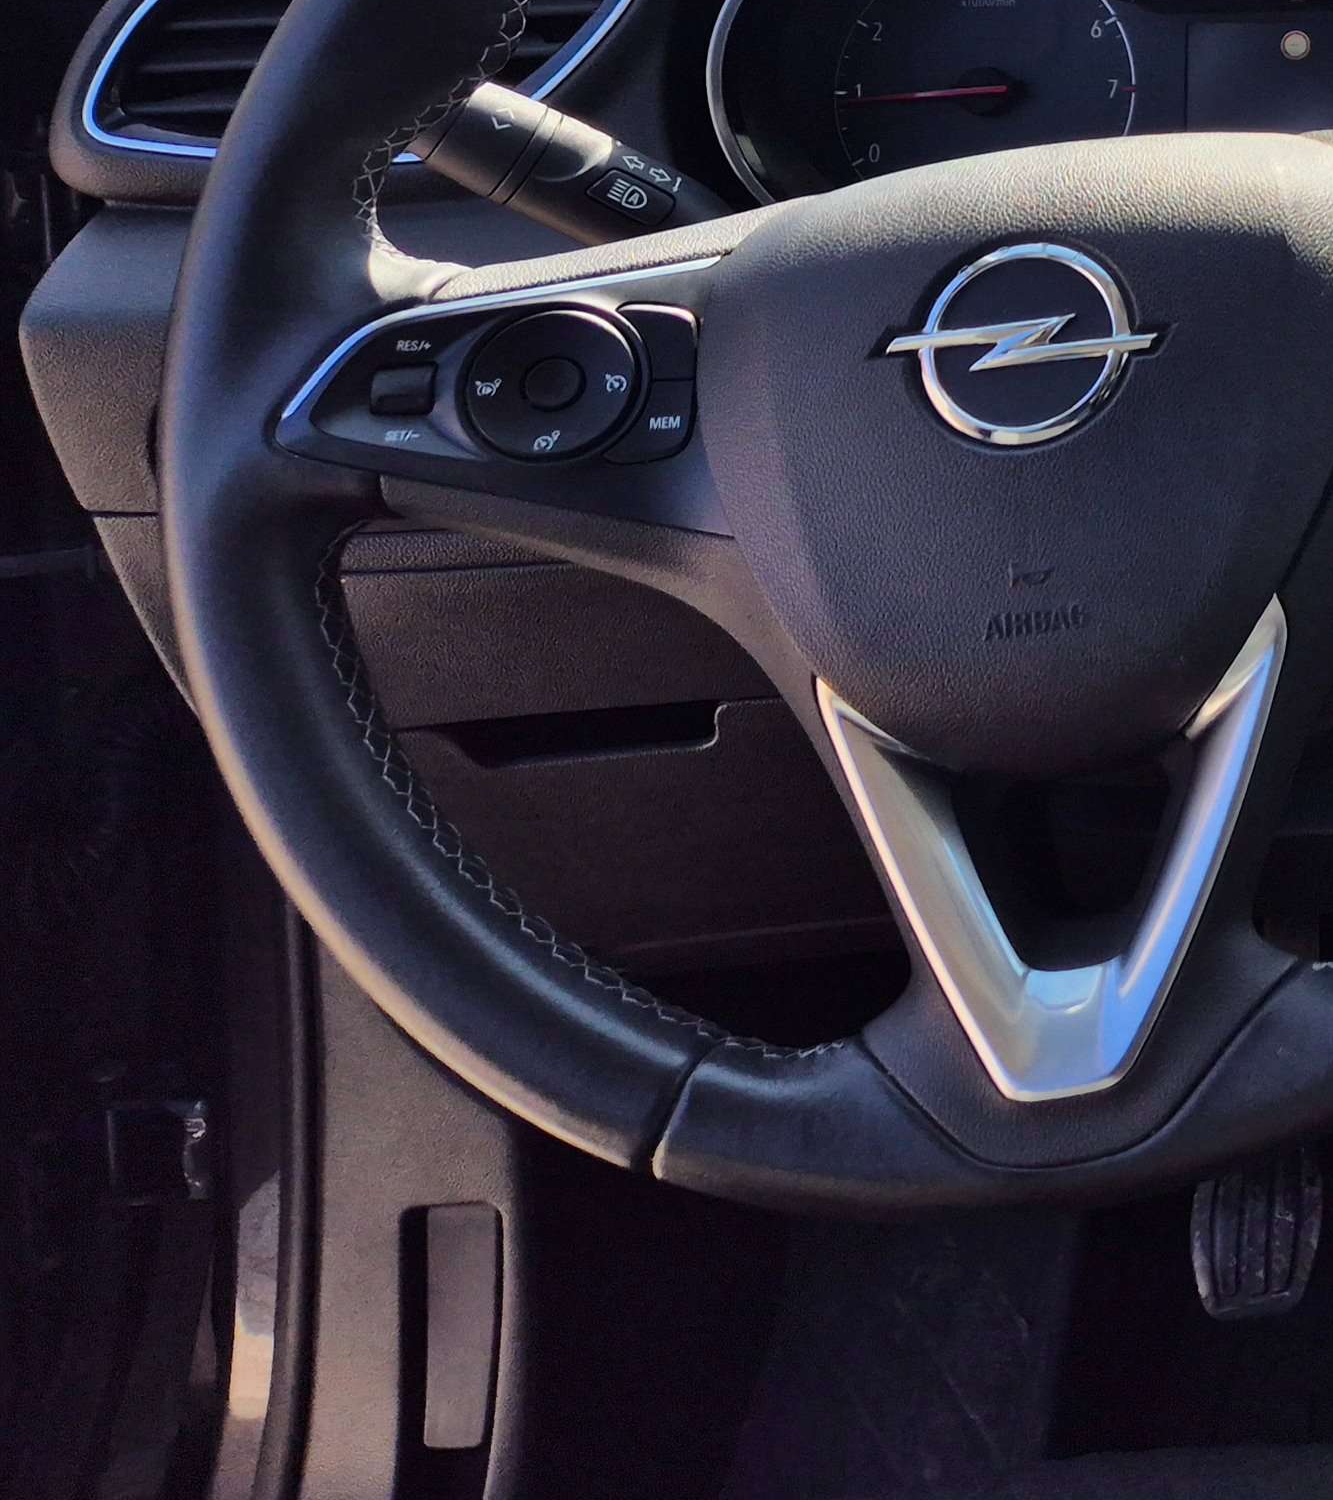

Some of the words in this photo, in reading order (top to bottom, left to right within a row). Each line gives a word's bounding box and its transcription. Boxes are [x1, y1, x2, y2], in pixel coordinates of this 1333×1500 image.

[871, 22, 883, 42] 2
[1090, 21, 1102, 39] 6
[1107, 79, 1119, 99] 7
[868, 143, 881, 163] 0
[396, 340, 432, 352] RES/+
[650, 415, 681, 429] MEM
